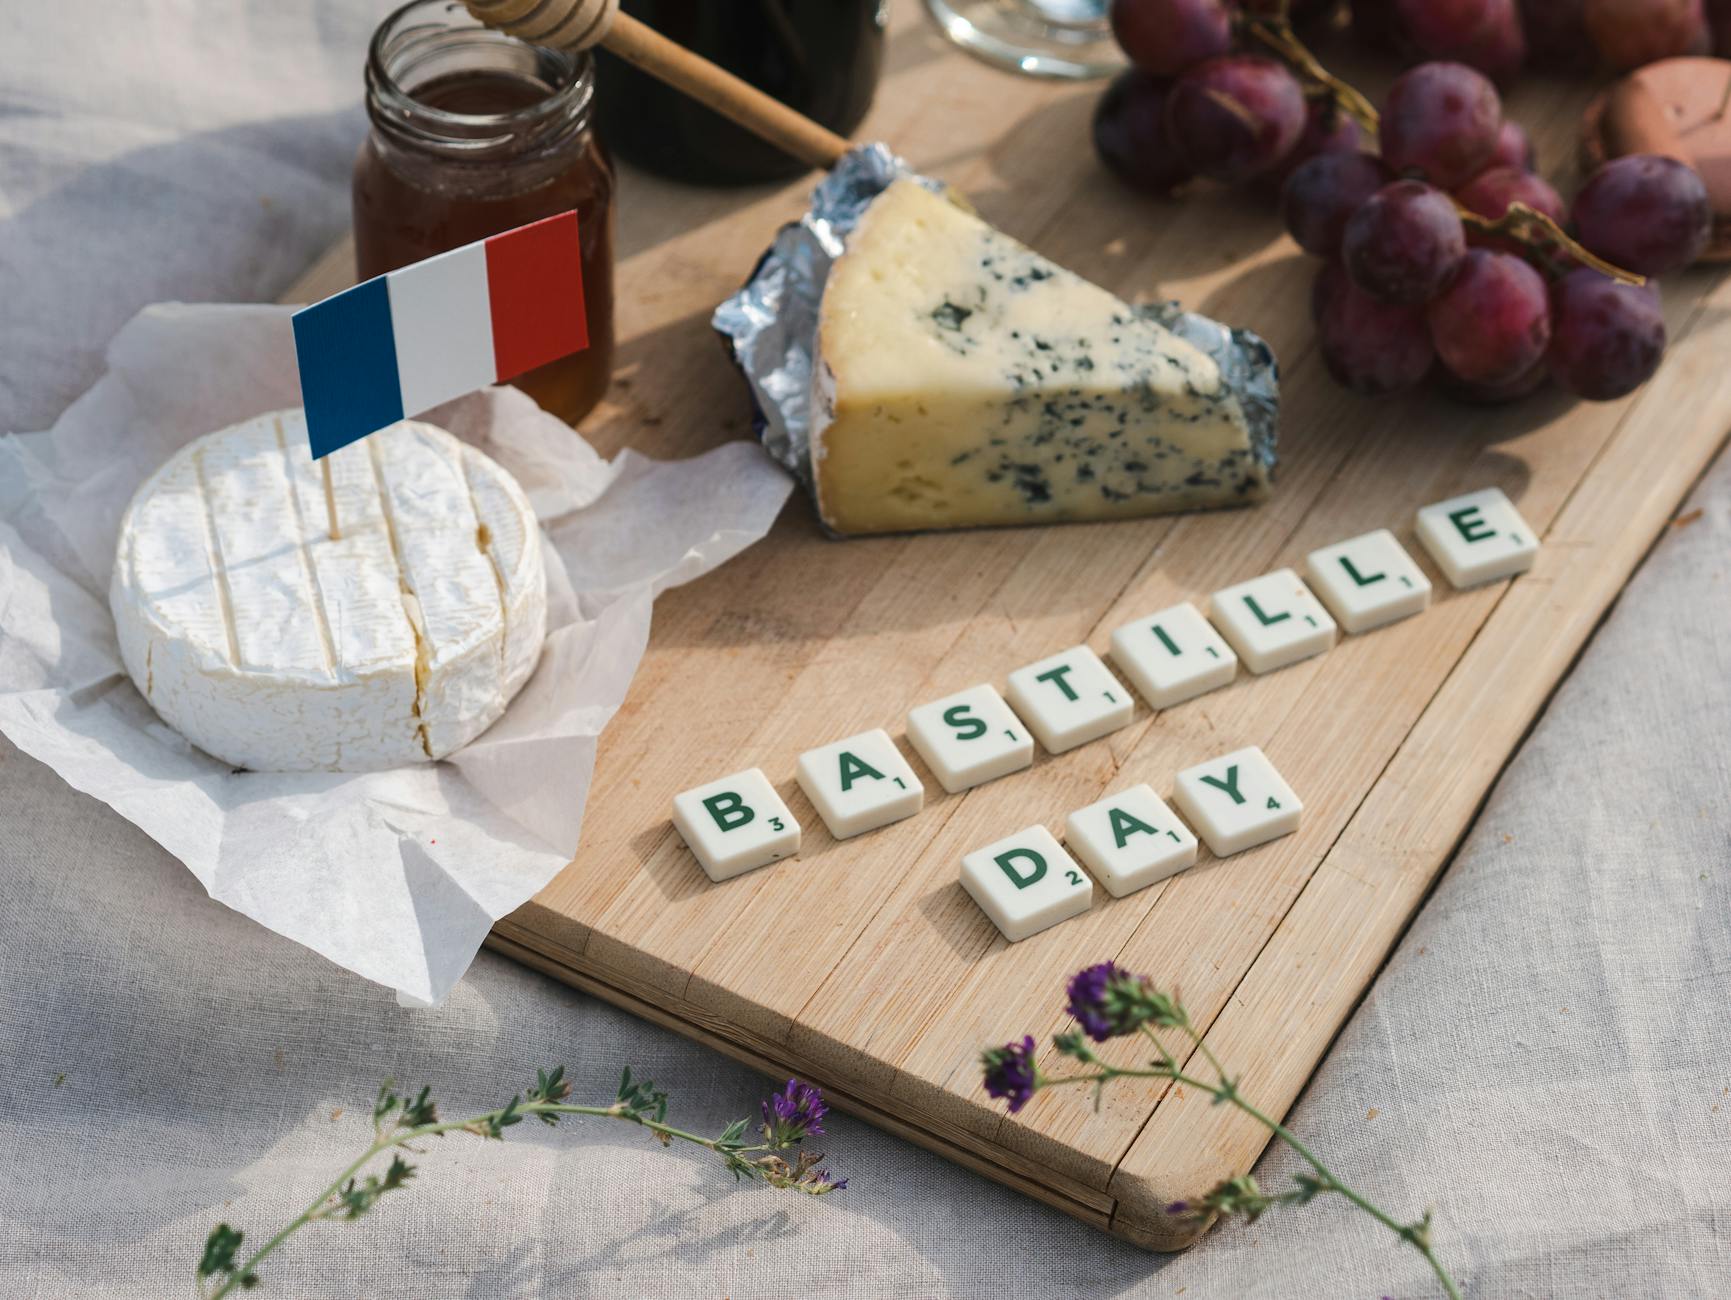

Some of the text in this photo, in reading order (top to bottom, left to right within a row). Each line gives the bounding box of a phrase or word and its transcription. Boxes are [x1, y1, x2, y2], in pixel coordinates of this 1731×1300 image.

[702, 505, 1497, 833] BASTILLE
[1103, 692, 1115, 704] 1
[1005, 729, 1017, 742] 1
[893, 777, 907, 790] 1
[1266, 796, 1281, 809] 4
[767, 816, 785, 832] 3
[994, 764, 1247, 890] DAY
[1166, 831, 1180, 843] 1
[1064, 870, 1083, 886] 2
